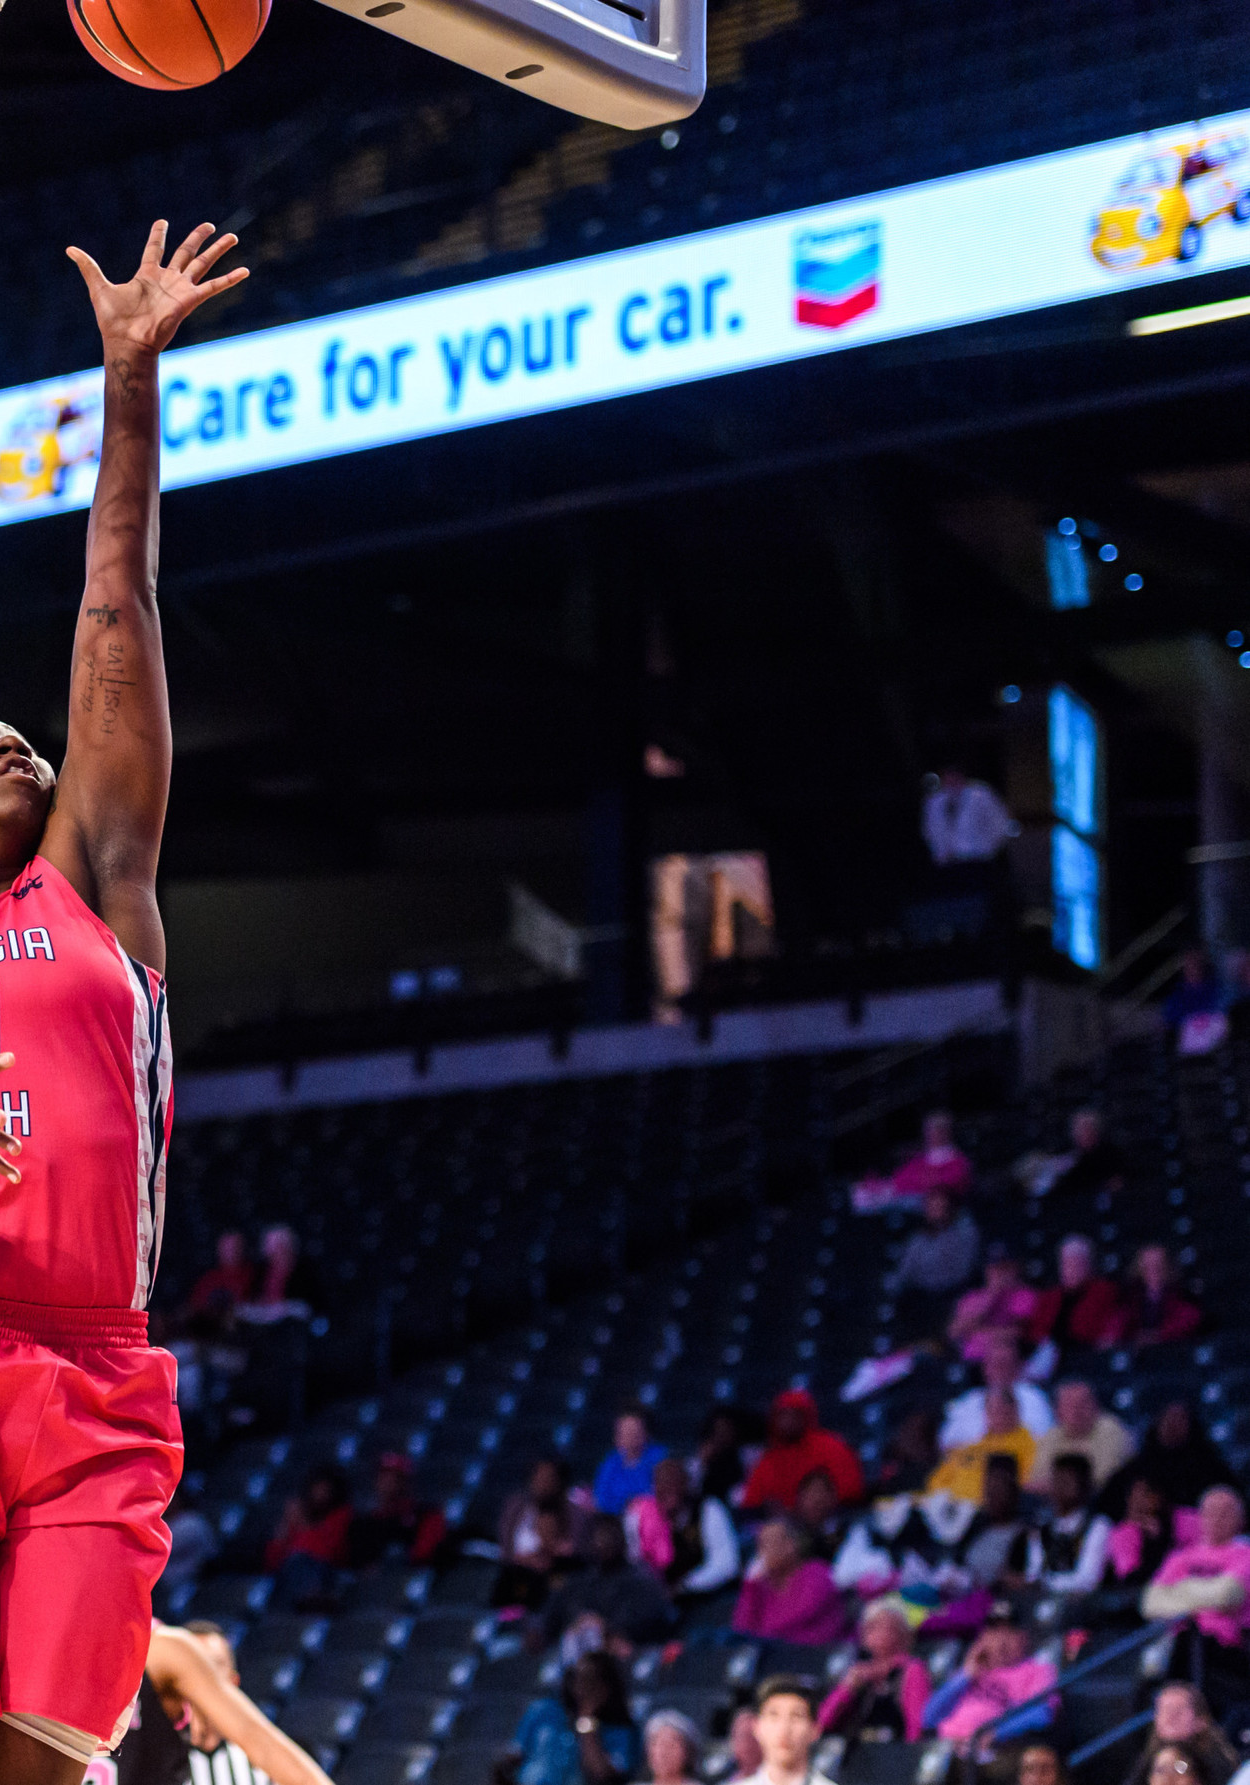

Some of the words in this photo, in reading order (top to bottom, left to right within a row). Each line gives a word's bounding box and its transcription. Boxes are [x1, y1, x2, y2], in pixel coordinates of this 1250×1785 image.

[159, 369, 296, 452] Care
[320, 337, 415, 421] for
[438, 303, 594, 413] your
[617, 272, 744, 353] car.
